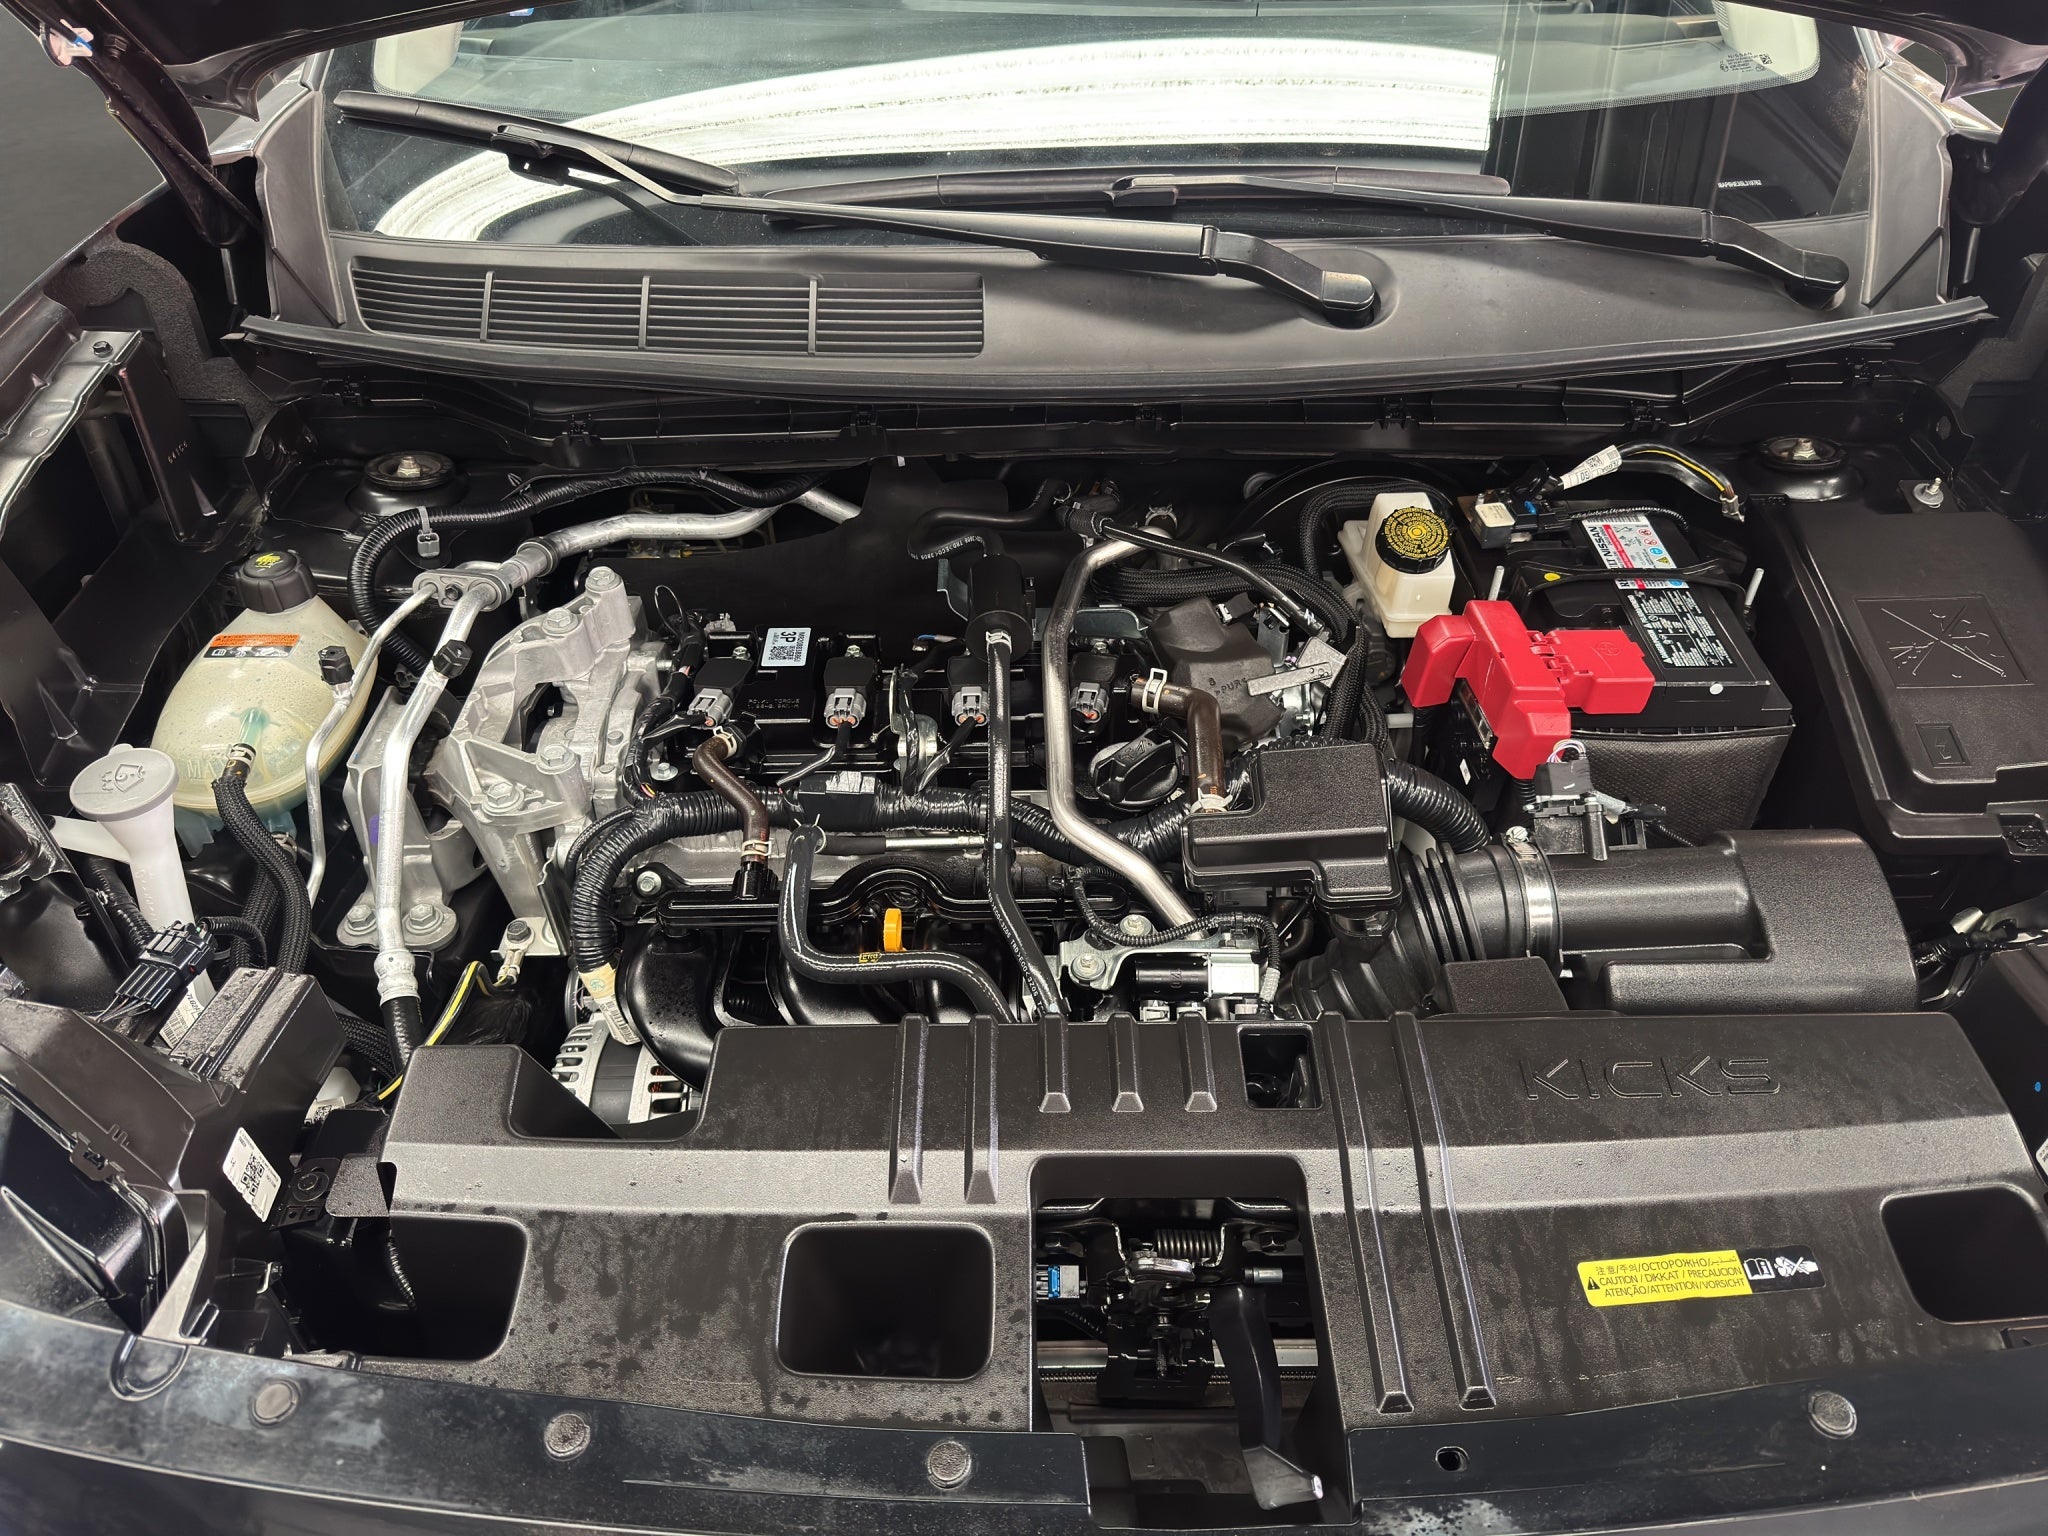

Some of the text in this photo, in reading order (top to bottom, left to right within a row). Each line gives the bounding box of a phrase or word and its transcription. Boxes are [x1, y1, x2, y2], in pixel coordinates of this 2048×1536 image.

[1588, 526, 1612, 557] NISSAN
[780, 631, 797, 643] 3P
[1519, 1055, 1780, 1099] KICKS
[1600, 1275, 1638, 1286] CAUTION
